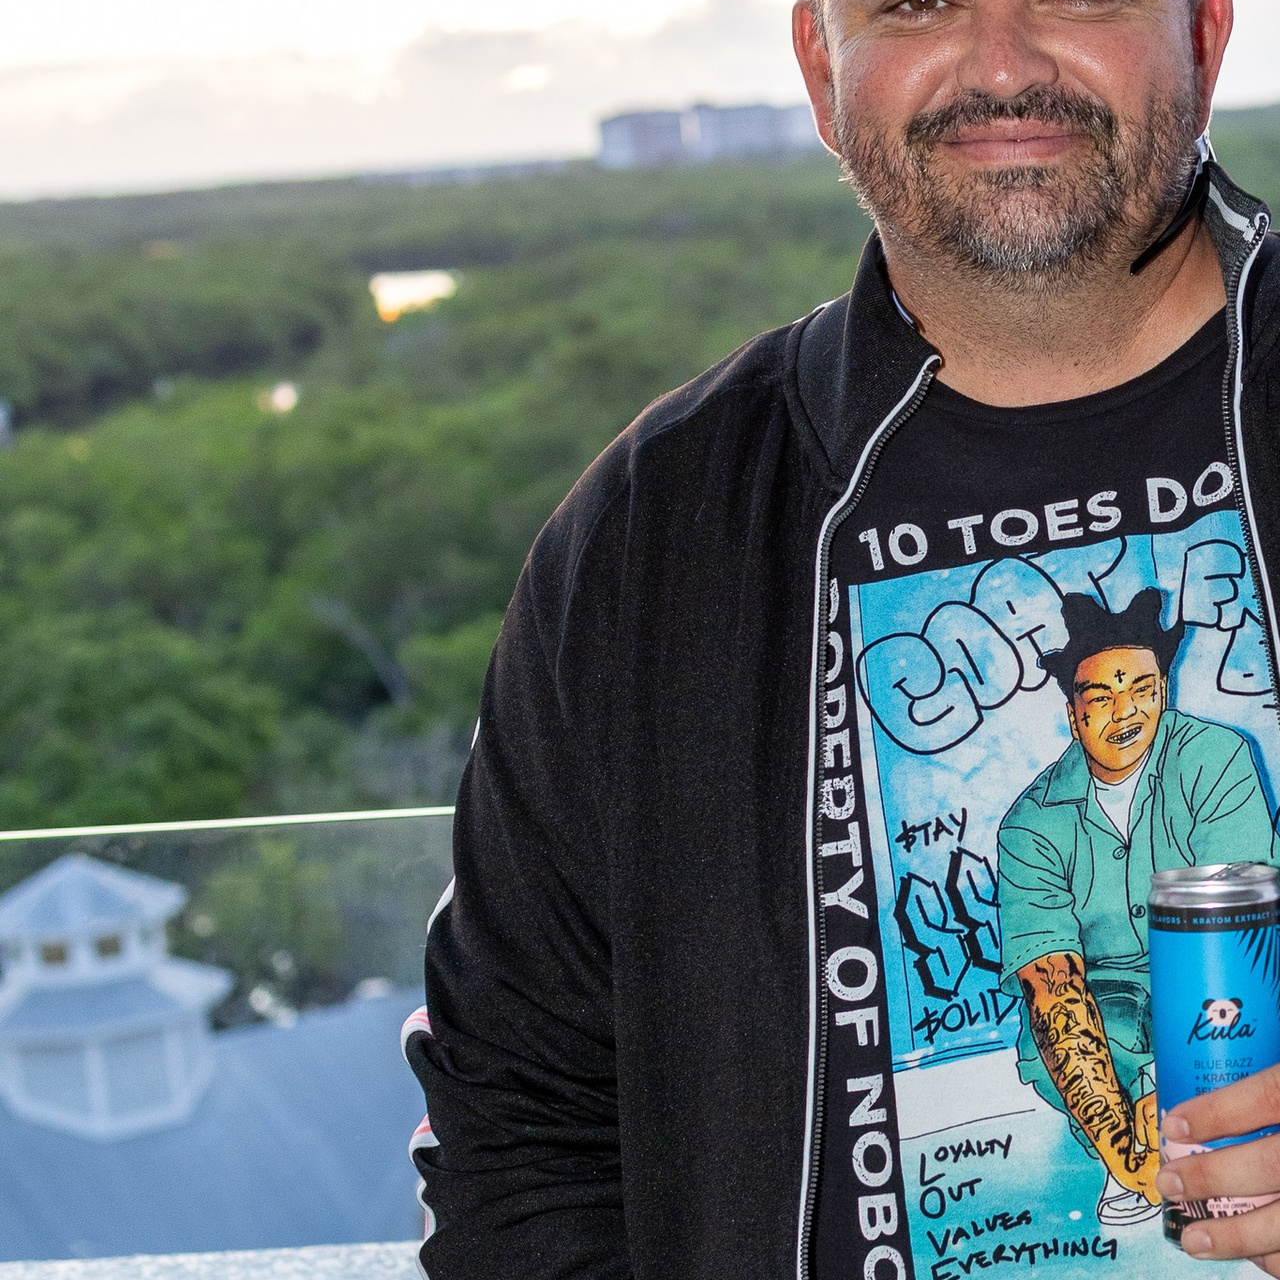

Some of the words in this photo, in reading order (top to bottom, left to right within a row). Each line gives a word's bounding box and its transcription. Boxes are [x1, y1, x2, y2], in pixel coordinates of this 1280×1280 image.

[858, 523, 929, 572] 10
[947, 490, 1122, 555] TOES
[1192, 915, 1232, 925] KRATOM
[1234, 910, 1270, 924] EXTRACT
[827, 945, 880, 1048] OF
[1187, 1011, 1257, 1046] Kula
[1193, 1059, 1222, 1070] BLUE
[1225, 1057, 1254, 1069] RAZZ
[1203, 1071, 1250, 1083] KRATOM
[919, 1178, 982, 1219] OUT
